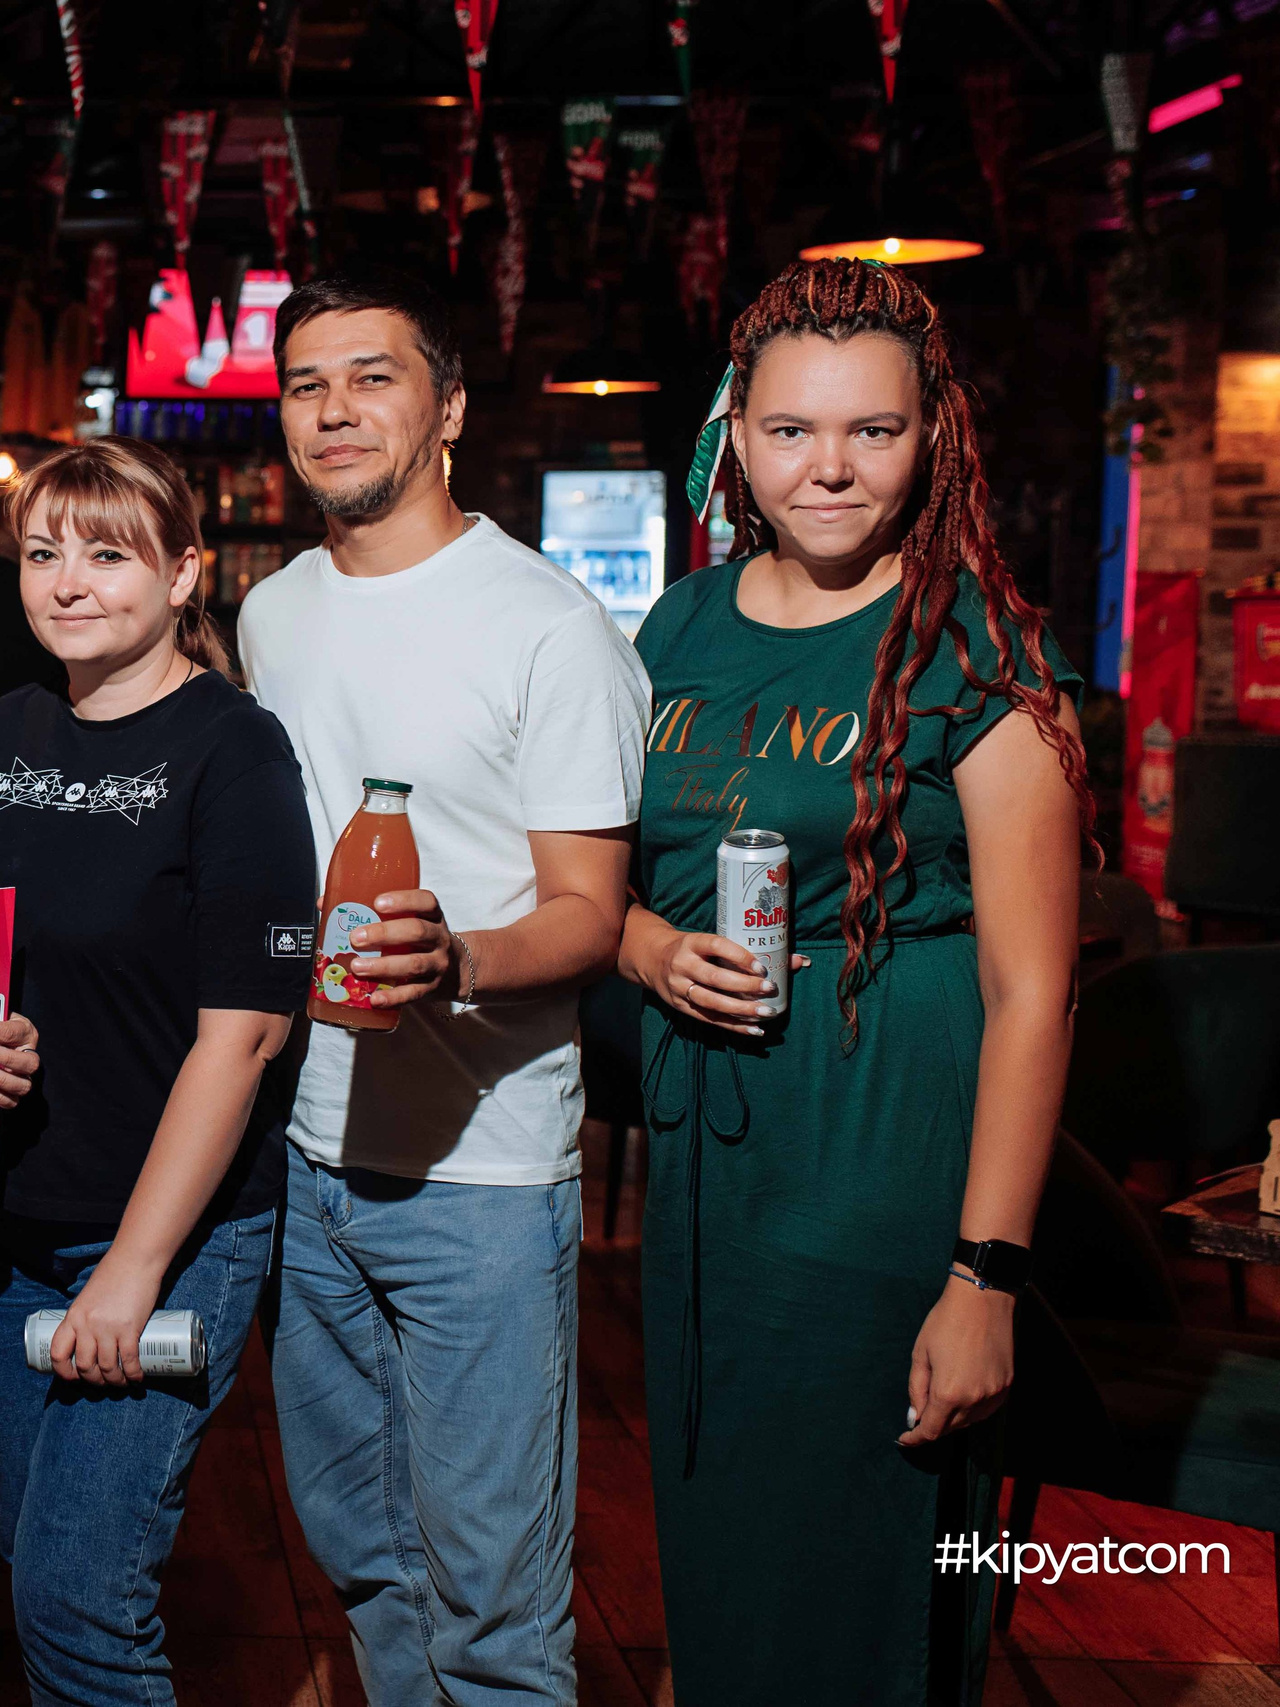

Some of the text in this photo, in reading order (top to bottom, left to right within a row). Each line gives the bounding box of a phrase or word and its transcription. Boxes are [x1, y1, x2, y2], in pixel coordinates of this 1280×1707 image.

[242, 311, 268, 348] 1
[665, 763, 750, 833] Italy
[348, 914, 371, 924] DALA
[278, 943, 296, 951] Kappa
